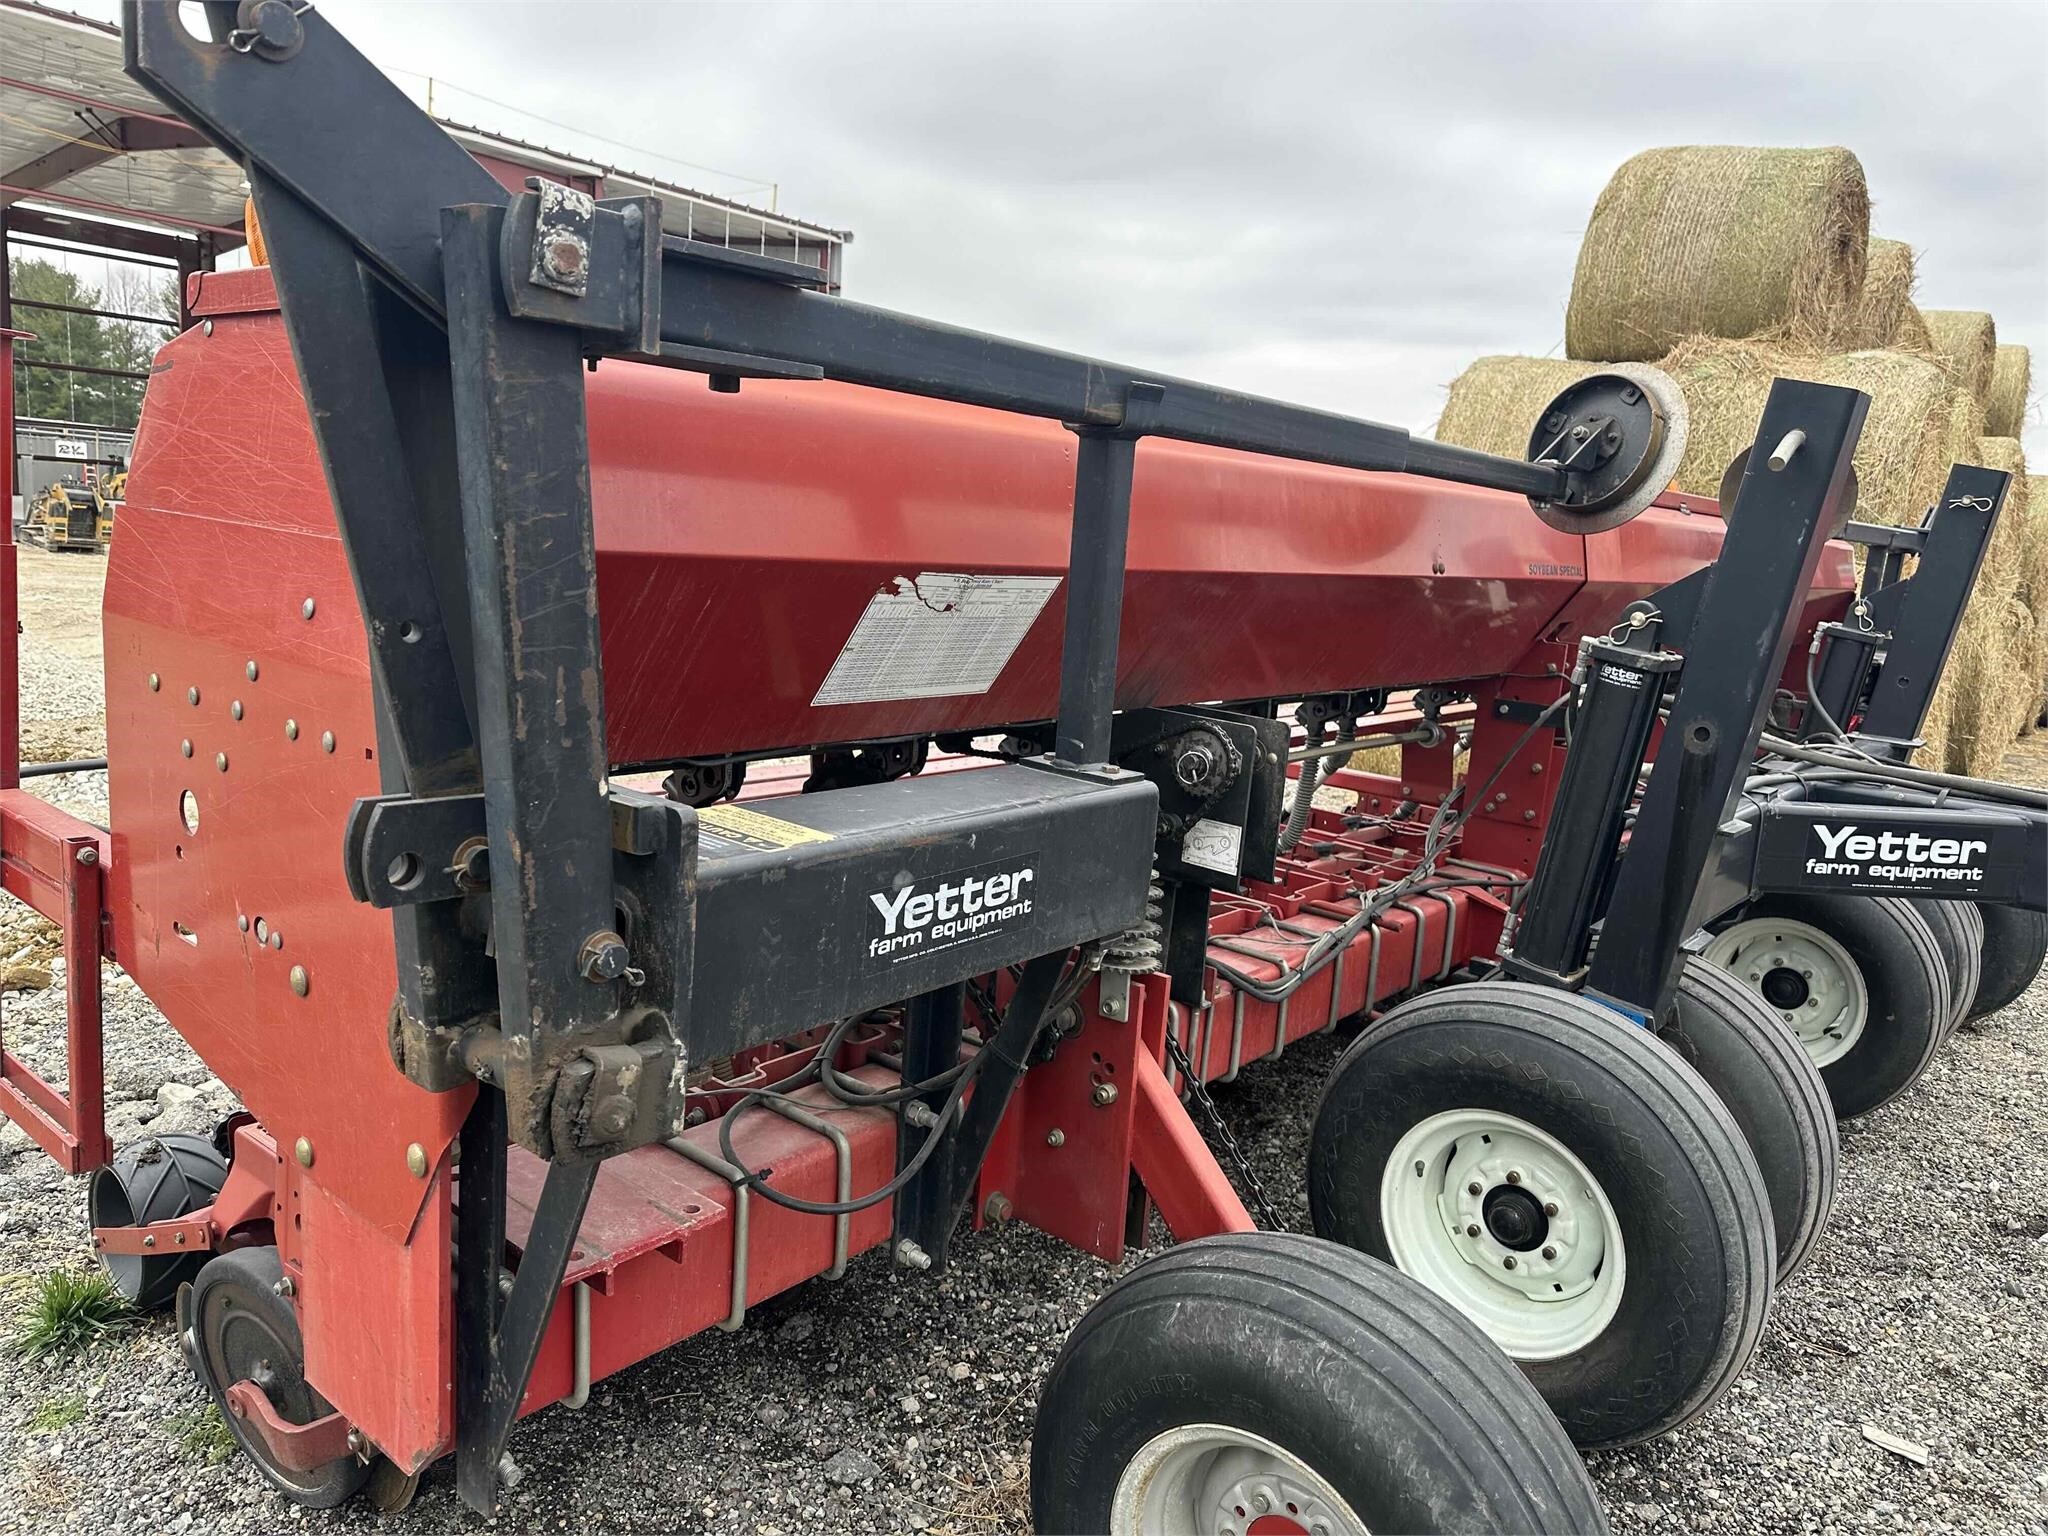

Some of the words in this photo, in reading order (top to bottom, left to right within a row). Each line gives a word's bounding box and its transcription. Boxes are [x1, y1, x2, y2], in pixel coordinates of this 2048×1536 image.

[1528, 563, 1558, 576] SOYBEAN
[1559, 565, 1583, 577] SPECIAL
[1812, 824, 1988, 865] Yetter
[1805, 858, 1860, 876] farm
[1868, 863, 1984, 882] equipment
[869, 868, 1034, 936] Yetter
[868, 930, 923, 958] farm
[931, 899, 1033, 939] equipment
[1101, 1372, 1194, 1419] UTILITY
